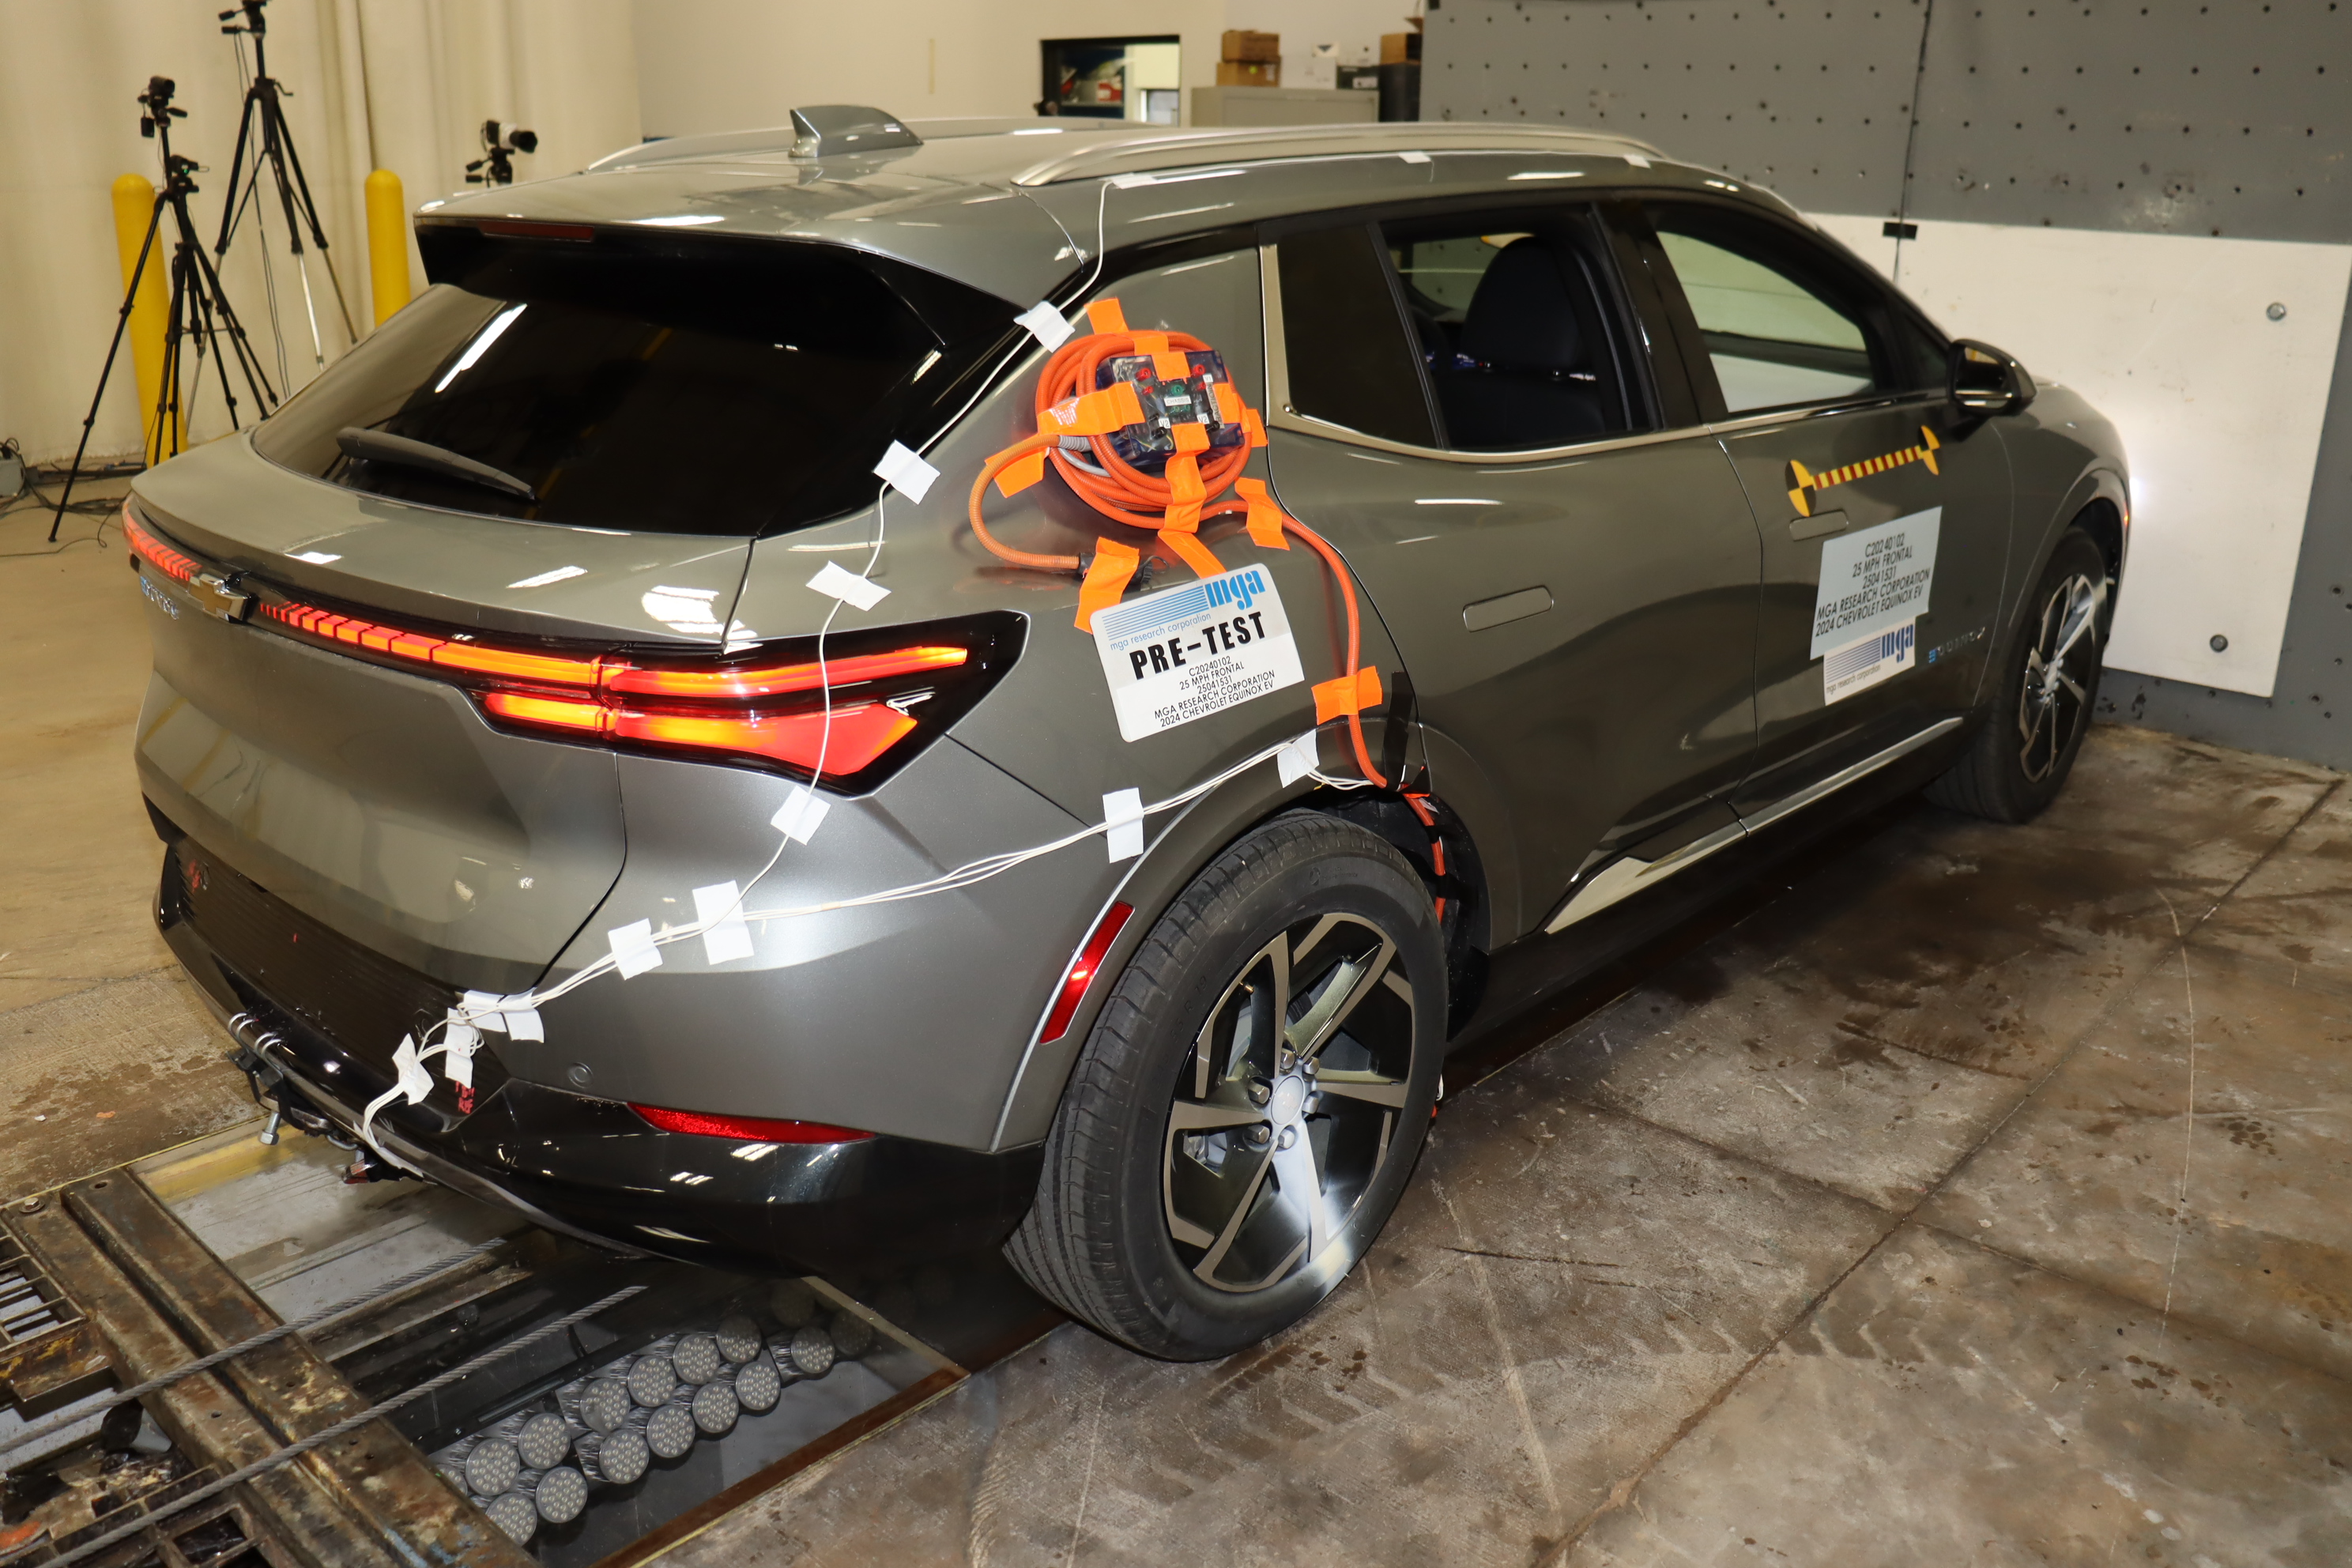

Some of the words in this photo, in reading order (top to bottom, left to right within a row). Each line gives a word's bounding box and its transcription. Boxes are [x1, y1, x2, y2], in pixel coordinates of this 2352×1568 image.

[1160, 420, 1170, 428] V2
[1852, 562, 1863, 579] 25
[1863, 556, 1881, 574] MPH
[1882, 545, 1913, 567] FRONTAL
[1865, 533, 1905, 558] C20240102
[1205, 570, 1266, 611] mga
[1816, 601, 1838, 622] MGA
[1839, 586, 1879, 612] RESEARCH
[1879, 567, 1931, 597] CORPORATION
[1862, 565, 1897, 590] 25041531
[1815, 617, 1834, 638] 2024
[1836, 601, 1880, 629] CHEVROLET
[1880, 587, 1913, 612] EQUINOX
[1913, 584, 1924, 599] EV
[1110, 639, 1129, 651] mga
[1130, 626, 1166, 644] research
[1167, 612, 1212, 632] corporation
[1129, 611, 1265, 680] PRE-TEST
[1881, 624, 1914, 663] mga
[1179, 680, 1190, 691] 25
[1192, 673, 1210, 687] MPH
[1211, 661, 1245, 681] FRONTAL
[1189, 655, 1231, 677] C20240102
[1826, 684, 1837, 695] mga
[1838, 673, 1856, 688] research
[1856, 664, 1881, 681] corporation
[1154, 705, 1177, 720] MGA
[1178, 691, 1219, 711] RESEARCH
[1220, 669, 1276, 696] CORPORATION
[1197, 674, 1233, 695] 25041531
[1159, 713, 1181, 728] 2024
[1182, 696, 1227, 720] CHEVROLET
[1228, 685, 1264, 704] EQUINOX
[1264, 680, 1274, 691] EV
